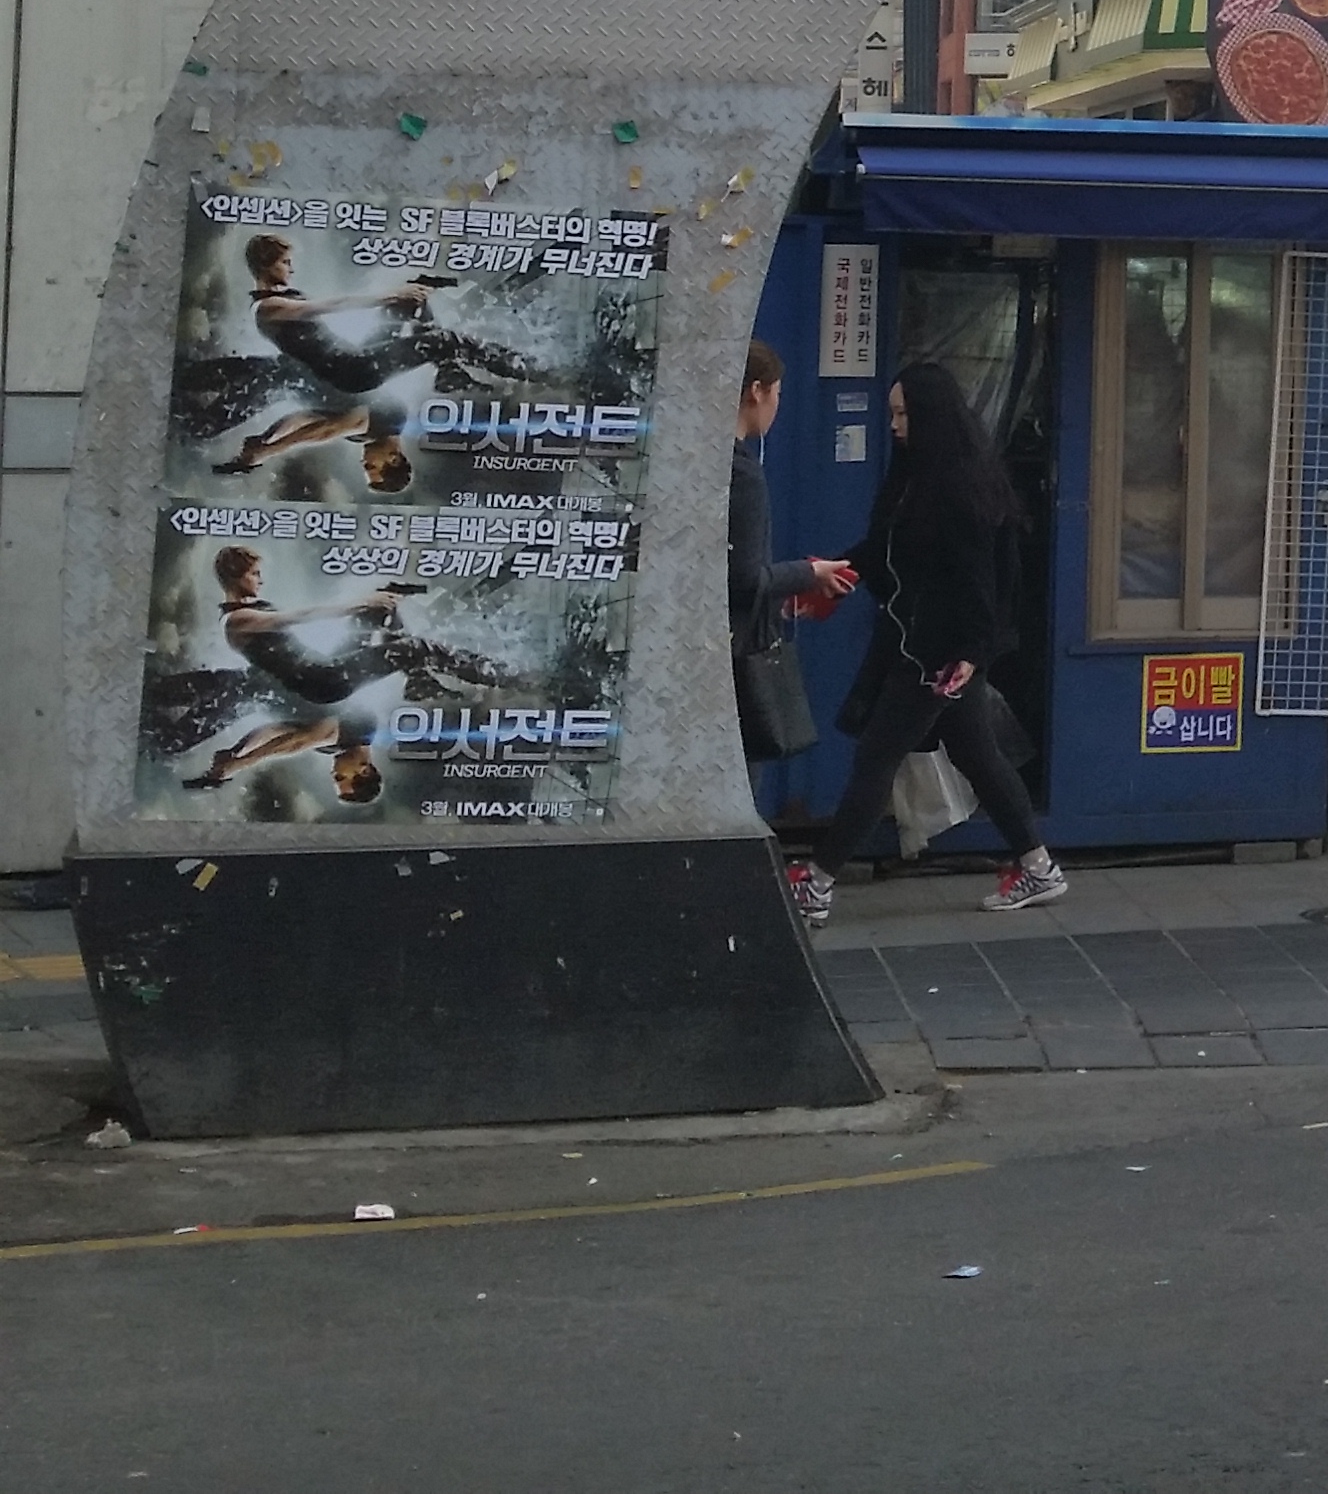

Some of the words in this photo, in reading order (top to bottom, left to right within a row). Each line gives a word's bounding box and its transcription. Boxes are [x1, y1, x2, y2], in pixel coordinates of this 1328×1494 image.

[201, 194, 329, 229] <인셉션>을
[335, 202, 388, 232] 잇는
[400, 206, 434, 233] SF
[439, 209, 591, 244] 블록버스터의
[598, 218, 659, 248] 혁명!
[352, 237, 440, 268] 상상의
[446, 243, 533, 273] 경계가
[540, 247, 653, 280] 무너진다
[833, 257, 851, 364] 국제전화카드
[857, 258, 873, 363] 일반전화카드
[418, 398, 641, 457] 인서전트
[473, 456, 579, 472] INSURGENT
[487, 493, 554, 510] IMAX
[170, 507, 299, 538] <인셉션>을
[304, 511, 357, 540] 잇는
[369, 514, 403, 540] SF
[409, 515, 561, 546] 블록버스터의
[567, 521, 629, 548] 혁명!
[321, 546, 408, 576] 상상의
[416, 548, 503, 578] 경계가
[510, 552, 624, 581] 무너진다
[1152, 664, 1235, 706] 금이빨
[389, 707, 612, 762] 인서전트
[1180, 715, 1233, 742] 삽니다
[443, 764, 548, 779] INSURGENT
[457, 802, 525, 818] IMAX
